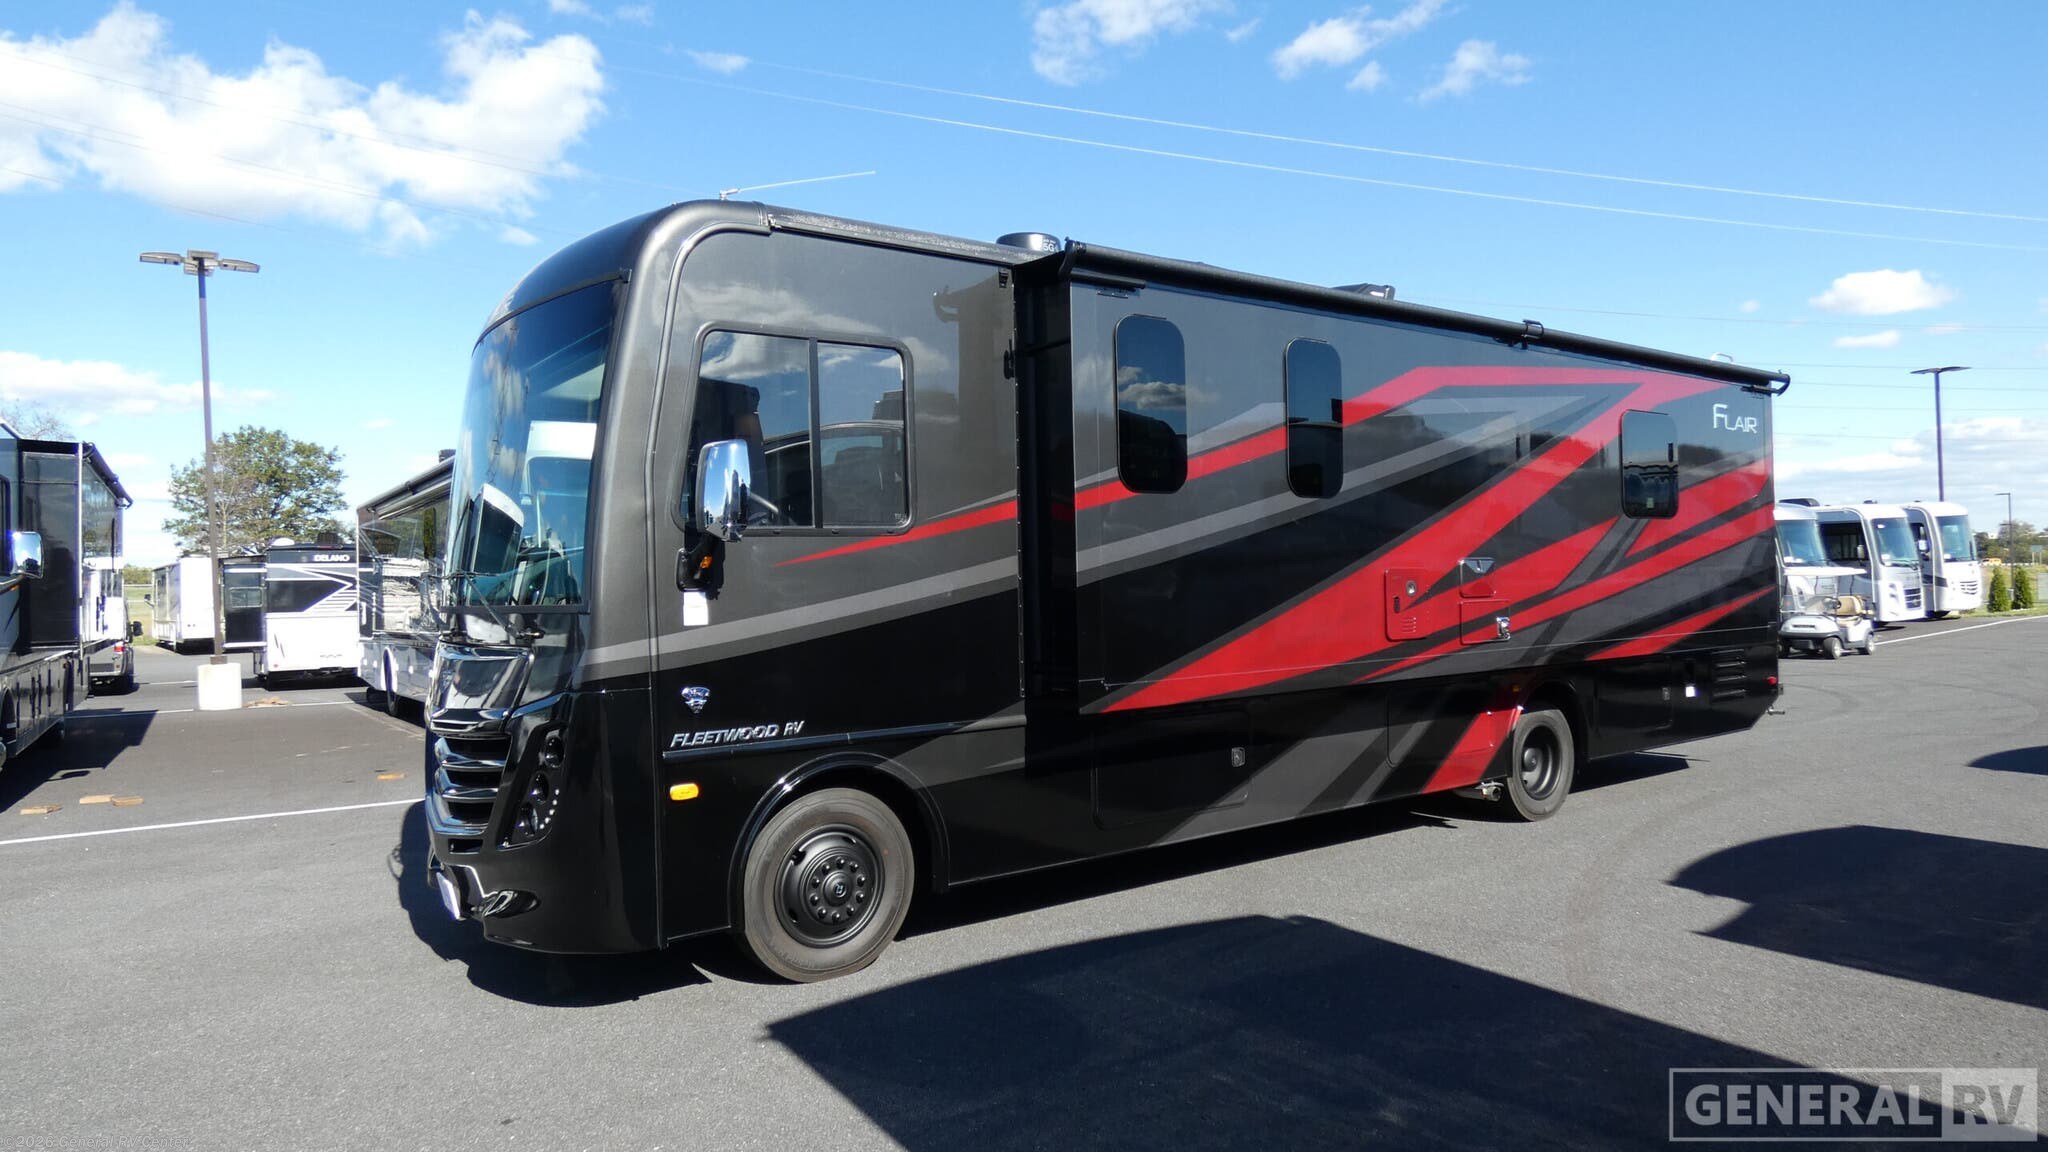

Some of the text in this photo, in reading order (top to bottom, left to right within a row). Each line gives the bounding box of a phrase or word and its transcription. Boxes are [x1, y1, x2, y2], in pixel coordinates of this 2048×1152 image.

[314, 554, 351, 562] DELANO
[670, 720, 805, 747] FLEETWOOD RV
